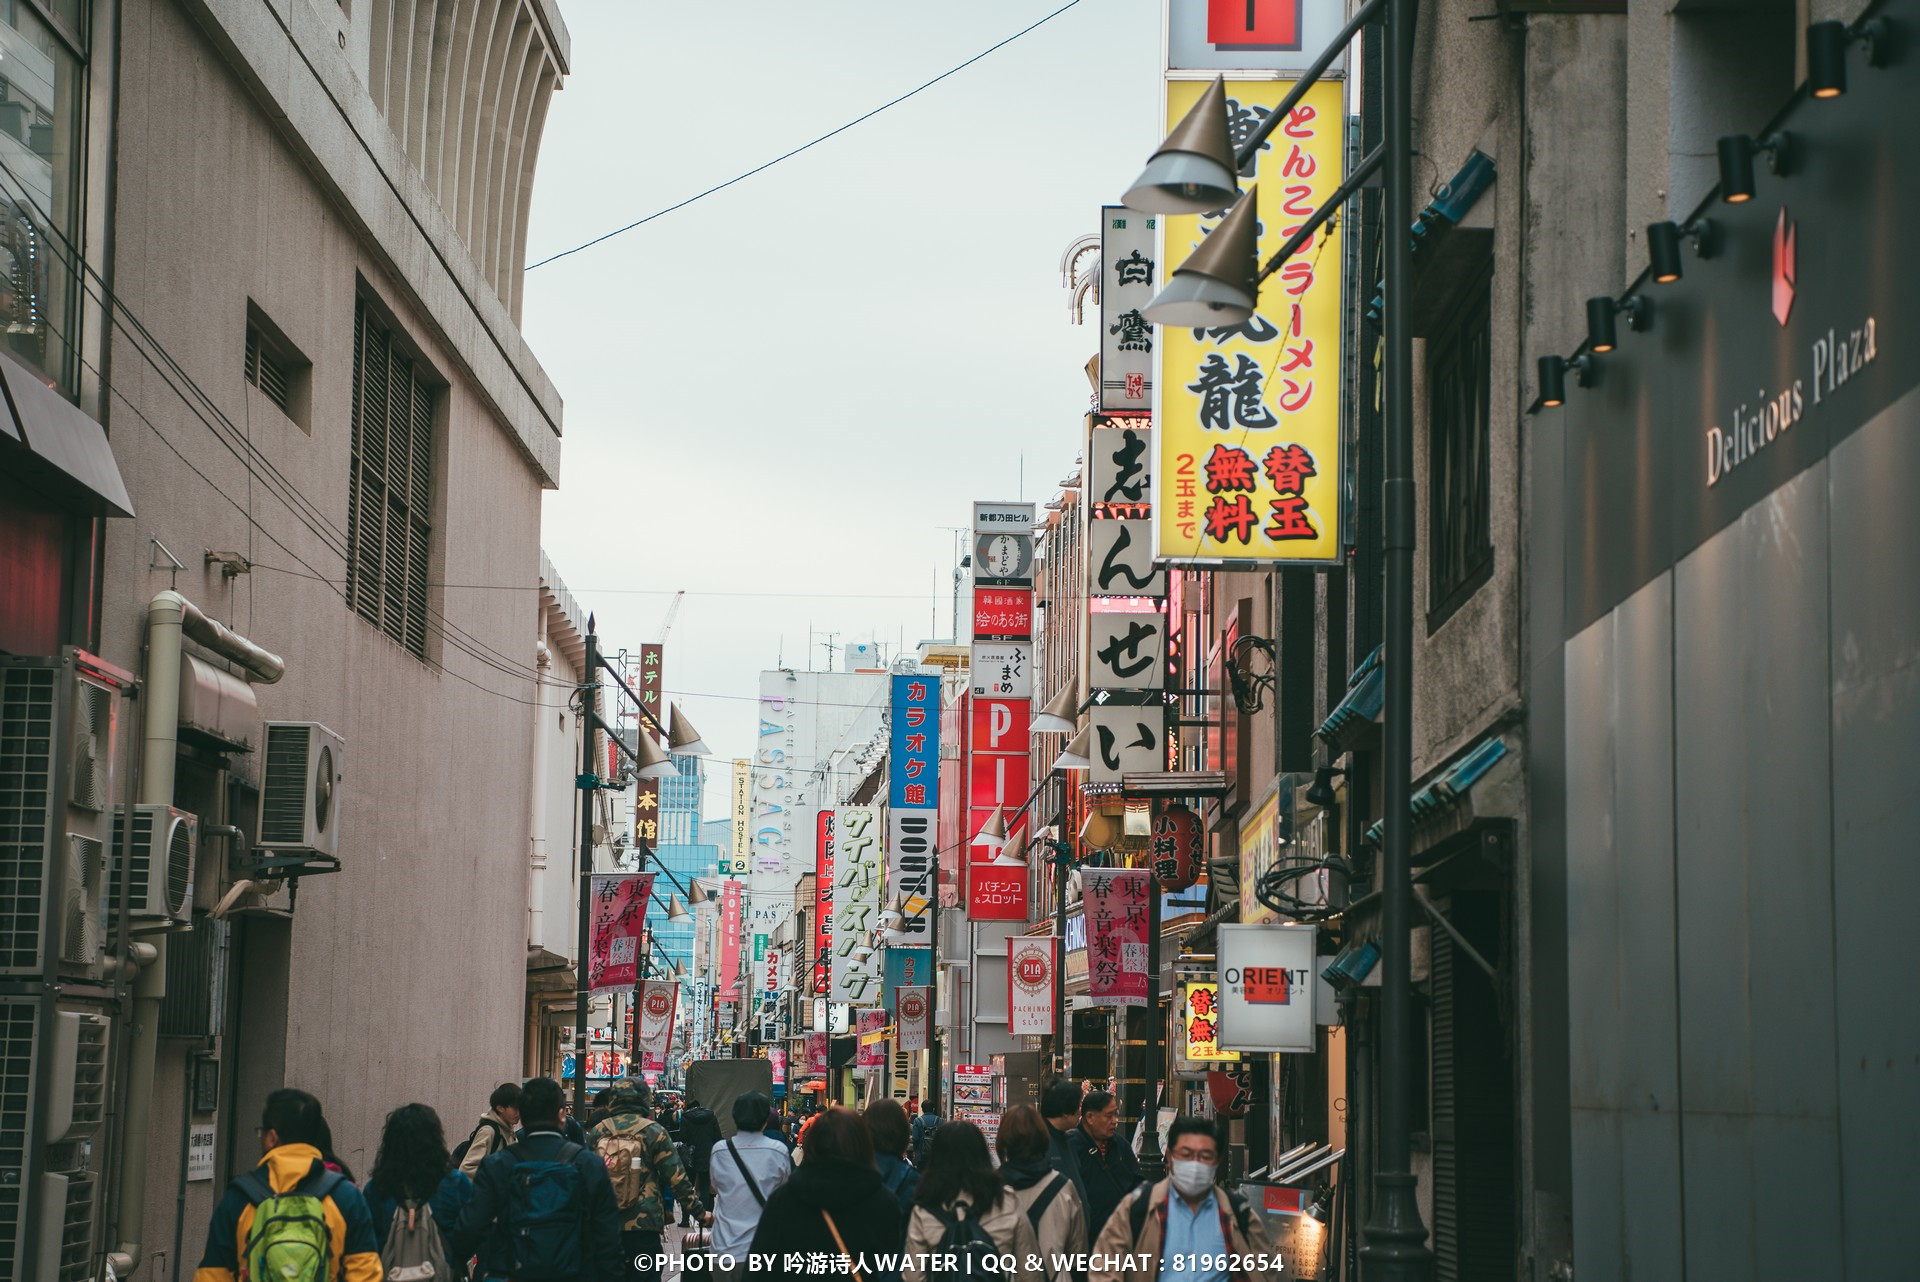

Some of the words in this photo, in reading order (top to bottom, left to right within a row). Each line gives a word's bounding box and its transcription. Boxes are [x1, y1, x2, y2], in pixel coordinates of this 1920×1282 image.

[1279, 105, 1317, 412] とんこつラーメン
[1706, 379, 1803, 486] Delicious
[1812, 317, 1878, 404] Plaza
[1175, 453, 1197, 540] 2玉まで
[1204, 443, 1260, 544] 無料
[1262, 443, 1319, 540] 替玉
[644, 651, 659, 704] ホテル
[904, 681, 927, 805] カラオケ館
[737, 820, 745, 853] HOSTEL
[1153, 815, 1179, 880] 小料理
[978, 881, 1021, 892] パチンコ
[727, 886, 736, 947] HOTEL
[765, 951, 779, 991] カメラ
[1023, 963, 1041, 975] PIA
[1225, 967, 1309, 986] ORIENT
[651, 999, 665, 1009] PIA
[907, 1003, 920, 1011] PIA
[1014, 1005, 1051, 1013] PACHINKO
[1189, 987, 1218, 1016] 替
[1189, 1016, 1218, 1044] 無
